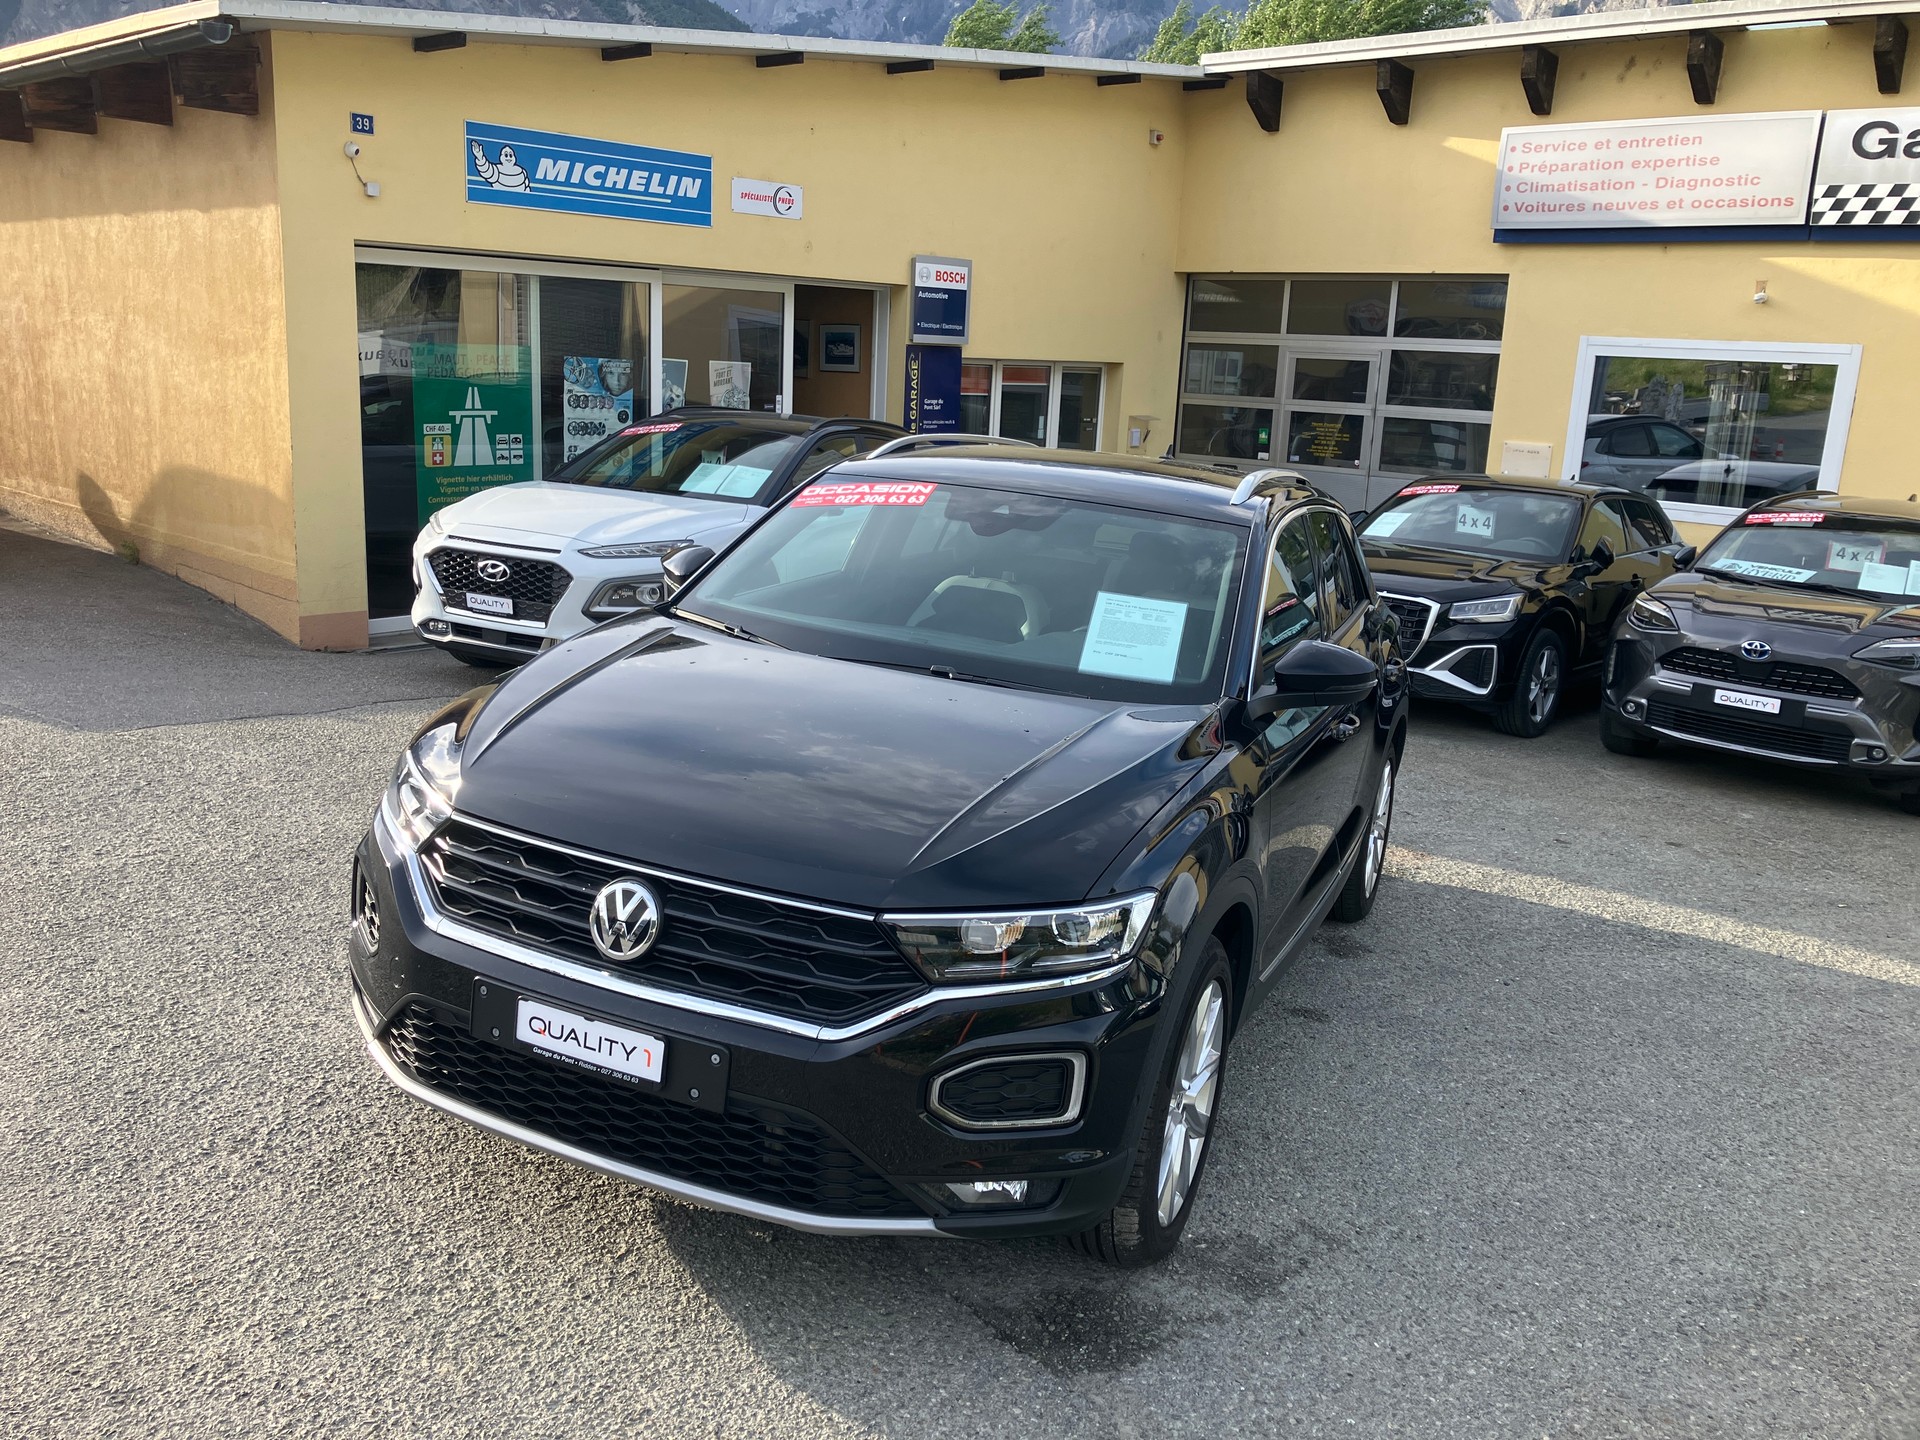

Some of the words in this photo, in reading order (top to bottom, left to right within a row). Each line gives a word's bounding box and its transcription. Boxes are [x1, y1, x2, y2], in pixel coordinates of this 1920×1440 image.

[356, 117, 370, 131] 39
[1521, 140, 1588, 154] Service
[1594, 138, 1611, 150] et
[1617, 133, 1703, 149] entretien
[1519, 158, 1624, 175] Préparation
[1631, 154, 1720, 171] expertise
[535, 157, 702, 198] MICHELIN
[1516, 178, 1636, 194] Climatisation
[1655, 173, 1761, 191] Diagnostic
[778, 197, 795, 205] PNEUS
[1514, 200, 1586, 213] Voitures
[1592, 199, 1659, 211] neuves
[1666, 197, 1685, 209] et
[1690, 195, 1794, 209] occasions
[935, 270, 966, 284] BOSCH
[918, 291, 949, 300] Automotive
[434, 354, 467, 366] MAUT
[427, 367, 483, 378] PEDAGGIO
[910, 360, 919, 420] GARAGE
[425, 425, 437, 433] CHF
[435, 476, 465, 485] Vignette
[482, 473, 514, 481] erhältlich
[440, 486, 469, 495] Vignette
[802, 484, 934, 496] OCCASION
[835, 495, 858, 503] 027
[859, 494, 886, 503] 306
[888, 494, 906, 503] 63
[908, 494, 926, 503] 63
[1458, 513, 1467, 526] 4
[1470, 518, 1478, 528] x
[1482, 516, 1491, 529] 4
[1836, 546, 1846, 559] 4
[1850, 551, 1860, 561] x
[1864, 550, 1875, 563] 4
[470, 596, 505, 608] QUALITY
[1720, 694, 1769, 709] QUALITY
[529, 1016, 638, 1061] QUALITY
[643, 1048, 651, 1067] 1
[532, 1046, 552, 1058] Garage
[561, 1055, 575, 1064] Pont
[578, 1061, 597, 1071] Riddes
[600, 1067, 611, 1075] 027
[611, 1070, 623, 1079] 306
[631, 1075, 639, 1083] 63
